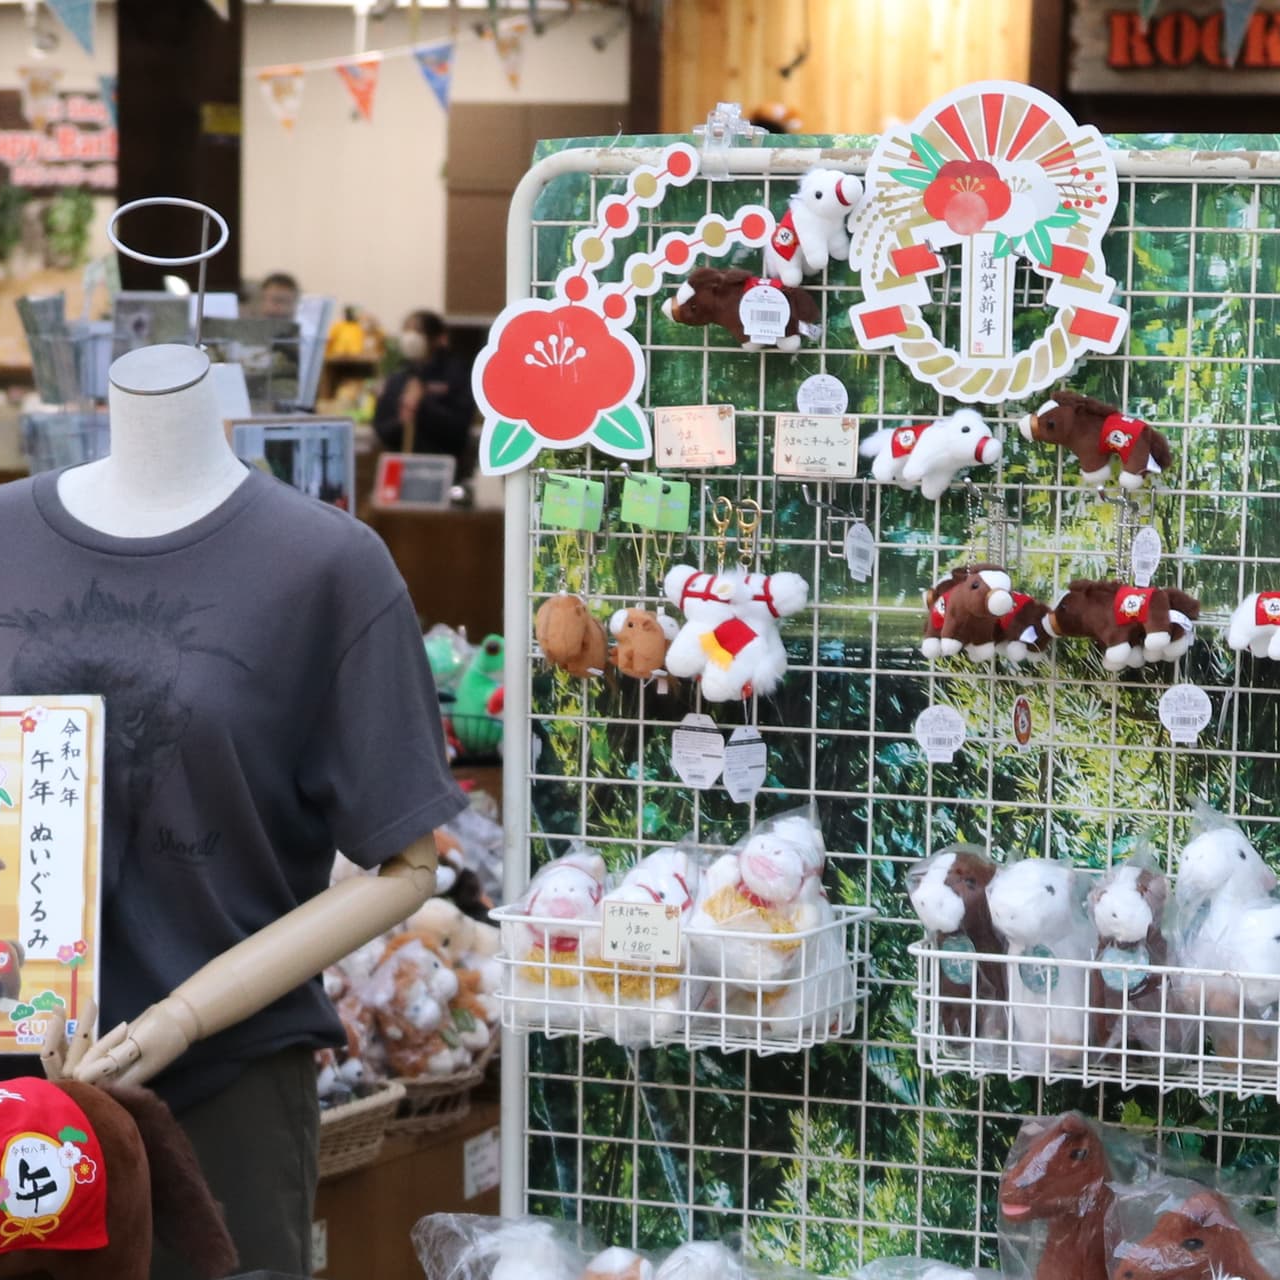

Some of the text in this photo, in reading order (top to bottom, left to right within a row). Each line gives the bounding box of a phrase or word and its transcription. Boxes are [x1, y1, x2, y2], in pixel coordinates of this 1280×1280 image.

[61, 718, 81, 808] 令和八年
[26, 749, 55, 950] 午年 ぬいぐるみ
[17, 1021, 76, 1036] CUE
[12, 1144, 48, 1157] 令和八年
[16, 1158, 57, 1214] 午
